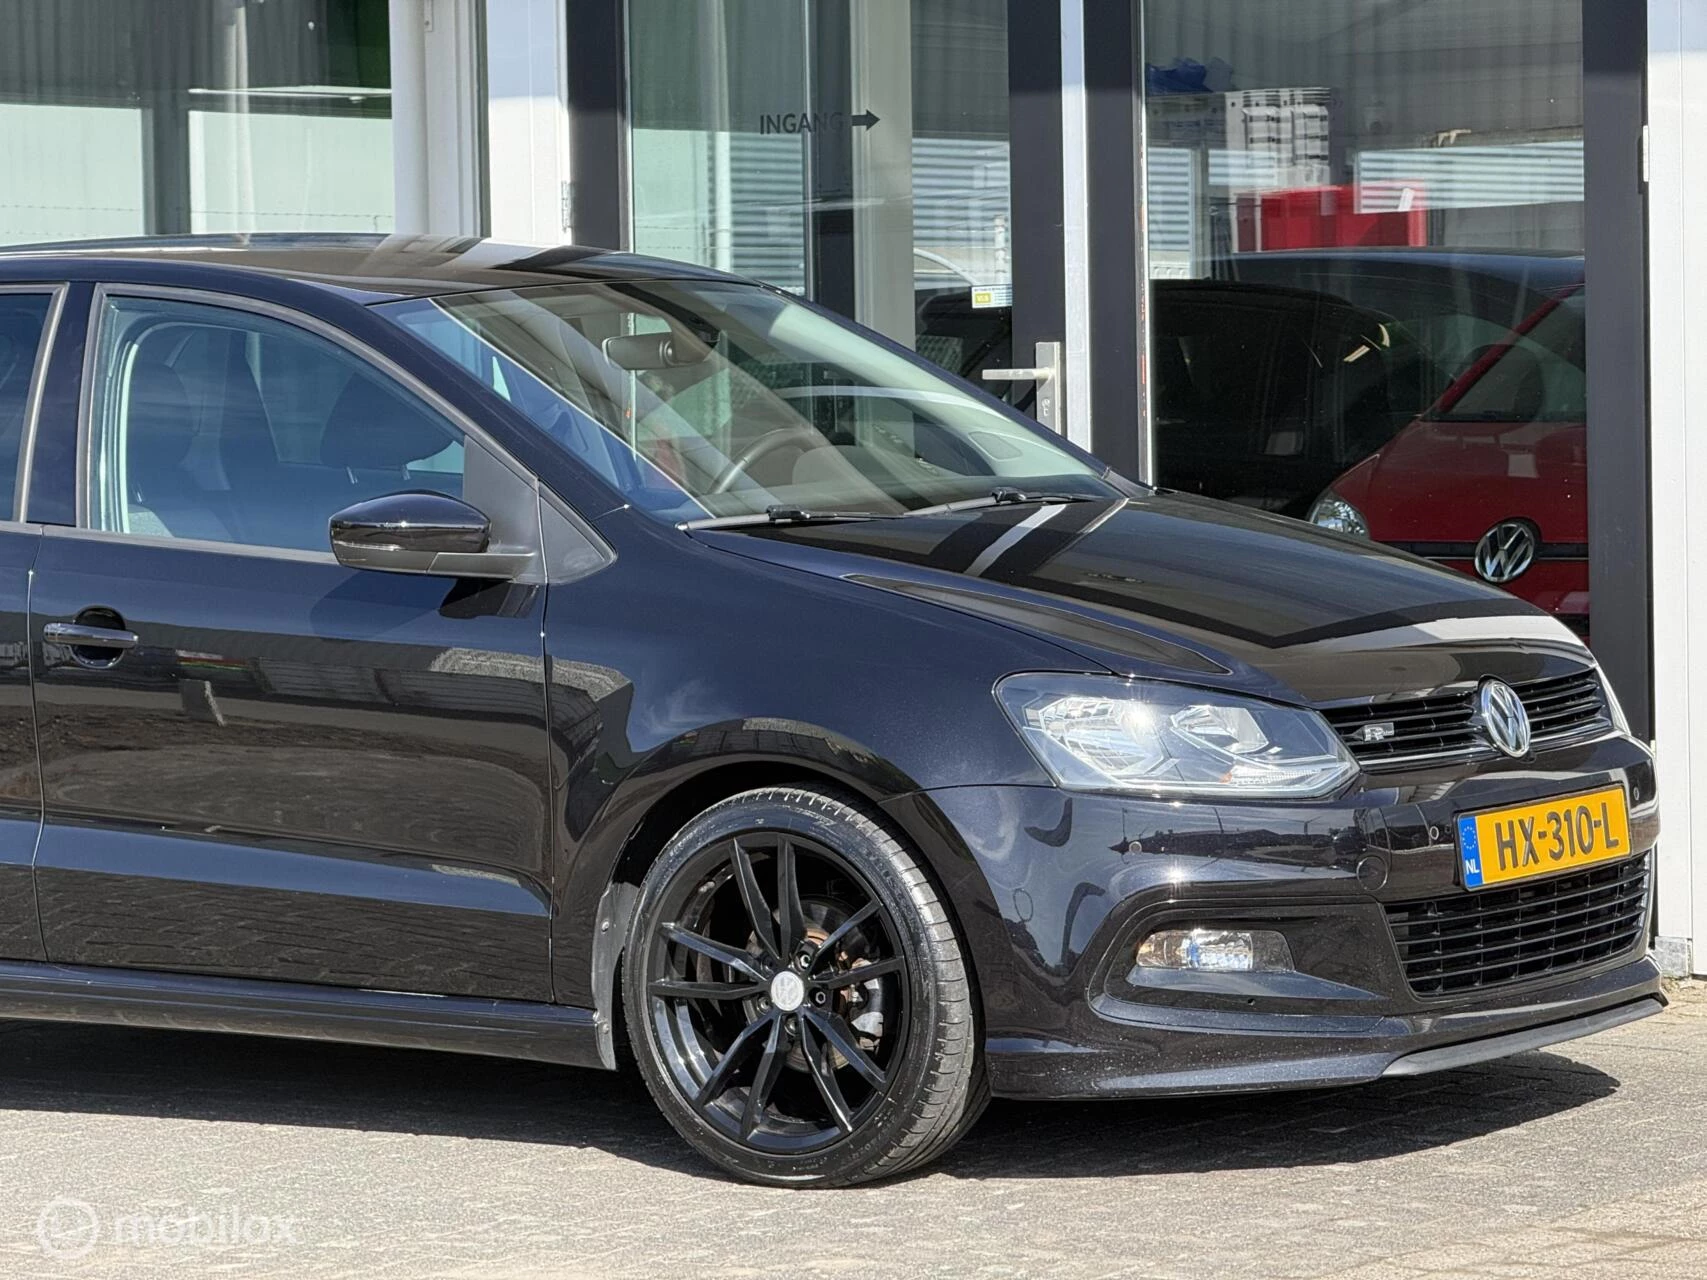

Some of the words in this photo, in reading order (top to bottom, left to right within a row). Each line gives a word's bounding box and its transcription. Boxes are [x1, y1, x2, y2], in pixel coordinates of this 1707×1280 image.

[760, 112, 845, 135] INGANG
[1495, 802, 1620, 871] HX-310-L
[1465, 859, 1480, 875] NL
